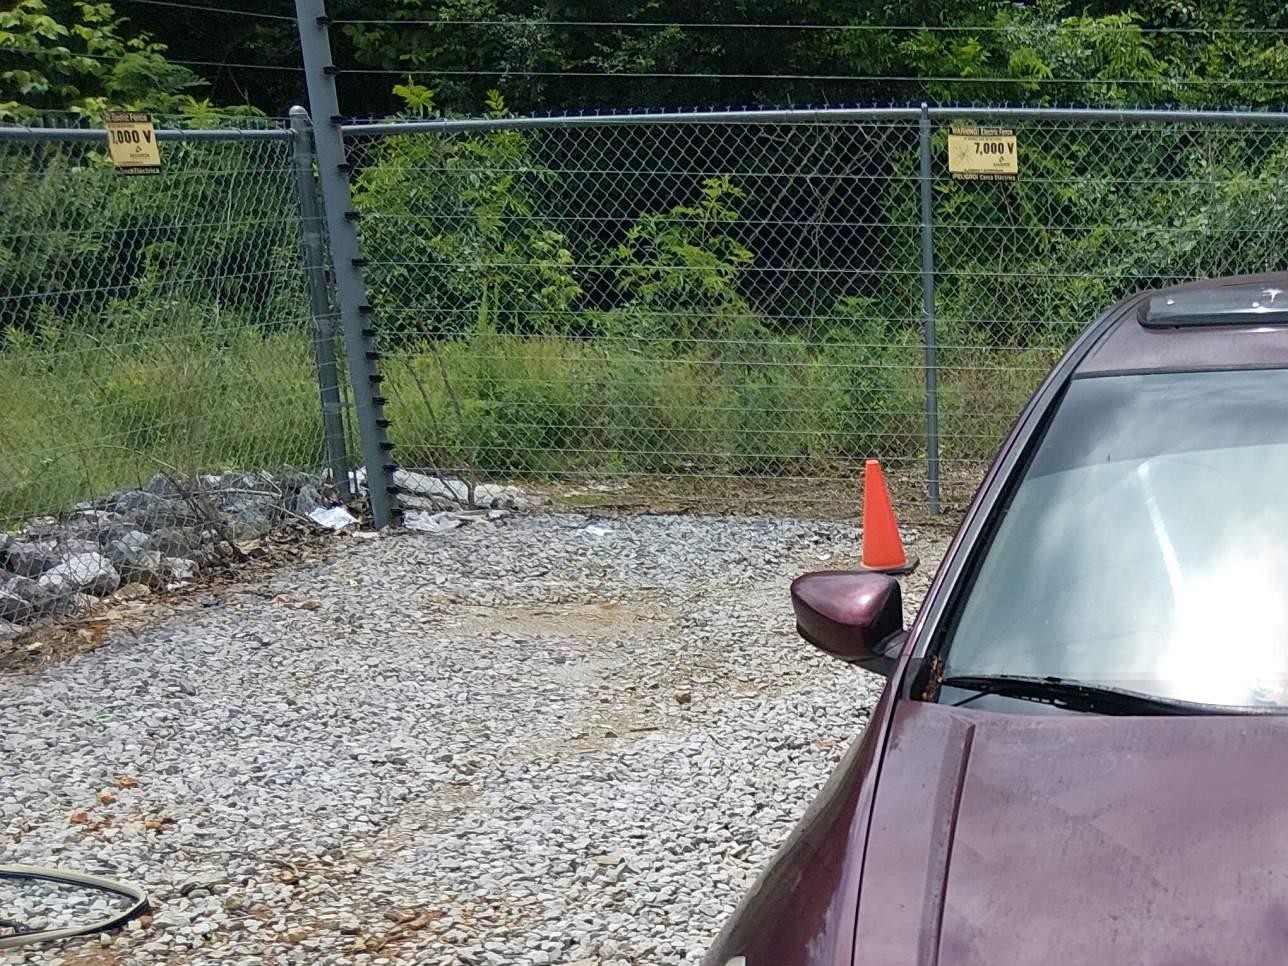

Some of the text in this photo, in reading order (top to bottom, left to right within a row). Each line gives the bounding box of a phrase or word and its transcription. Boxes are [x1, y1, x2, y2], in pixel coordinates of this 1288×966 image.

[143, 130, 151, 144] V
[974, 142, 1014, 155] 7,000 V
